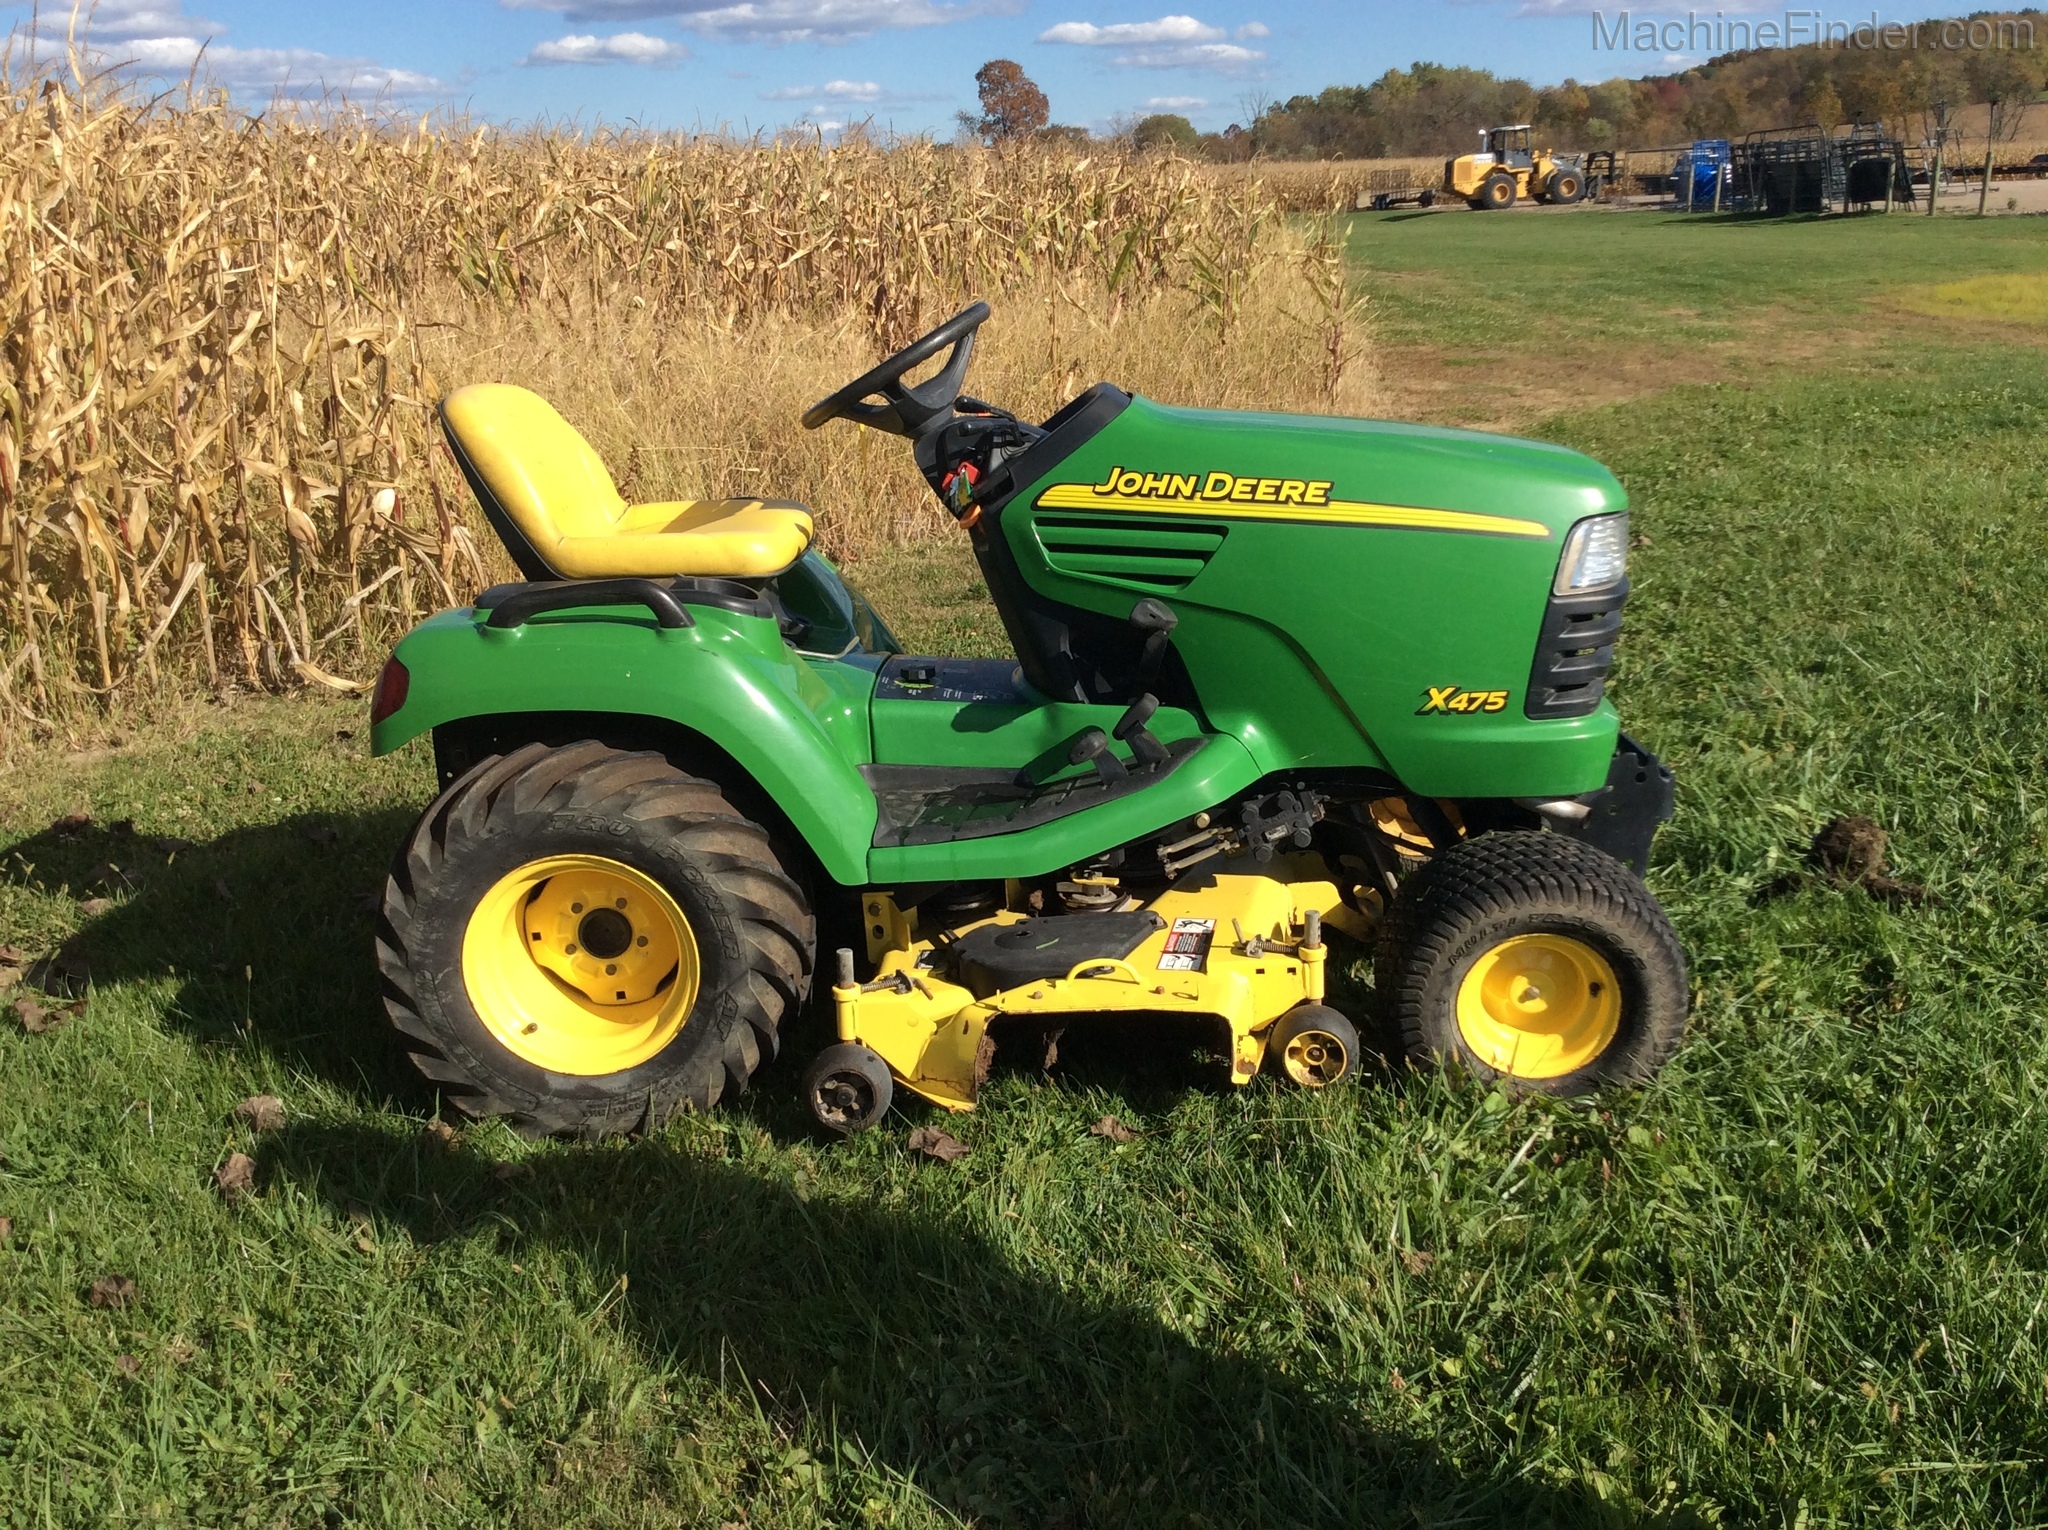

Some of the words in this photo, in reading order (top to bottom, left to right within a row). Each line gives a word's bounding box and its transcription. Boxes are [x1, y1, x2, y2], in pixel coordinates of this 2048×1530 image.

[1094, 466, 1199, 499] JOHN
[1200, 471, 1333, 506] DEERE
[1416, 686, 1509, 715] X475
[550, 813, 634, 837] TRU
[656, 845, 741, 960] POWER
